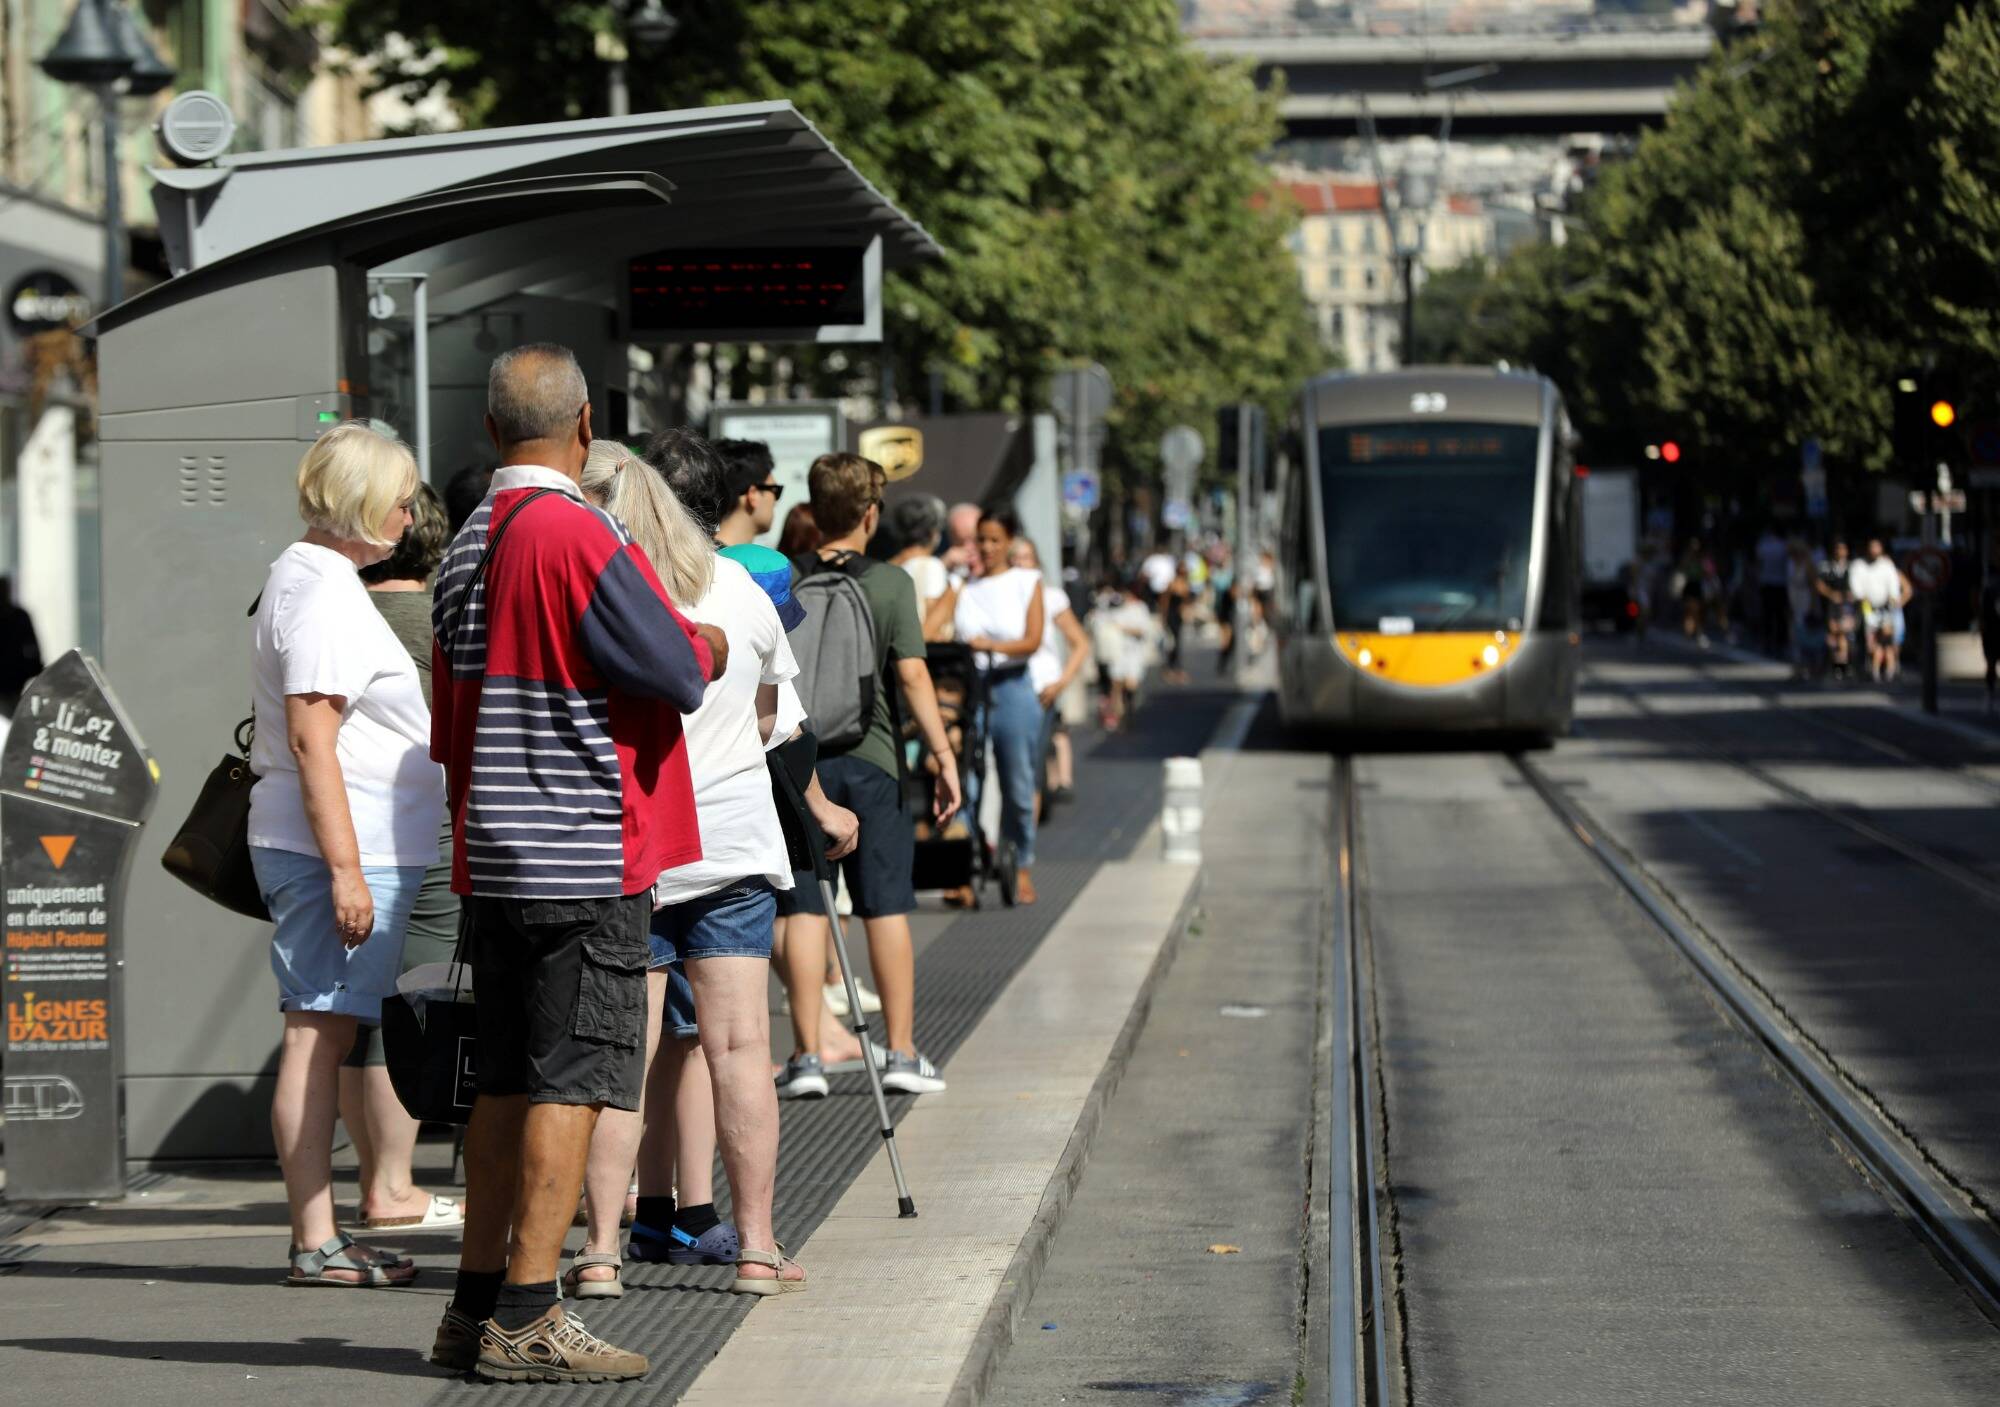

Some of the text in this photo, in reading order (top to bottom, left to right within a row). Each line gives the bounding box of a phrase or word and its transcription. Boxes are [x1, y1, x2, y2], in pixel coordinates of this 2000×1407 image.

[32, 727, 50, 752] &
[51, 736, 123, 769] montez
[7, 883, 105, 909] uniquement
[7, 907, 107, 927] en direction de
